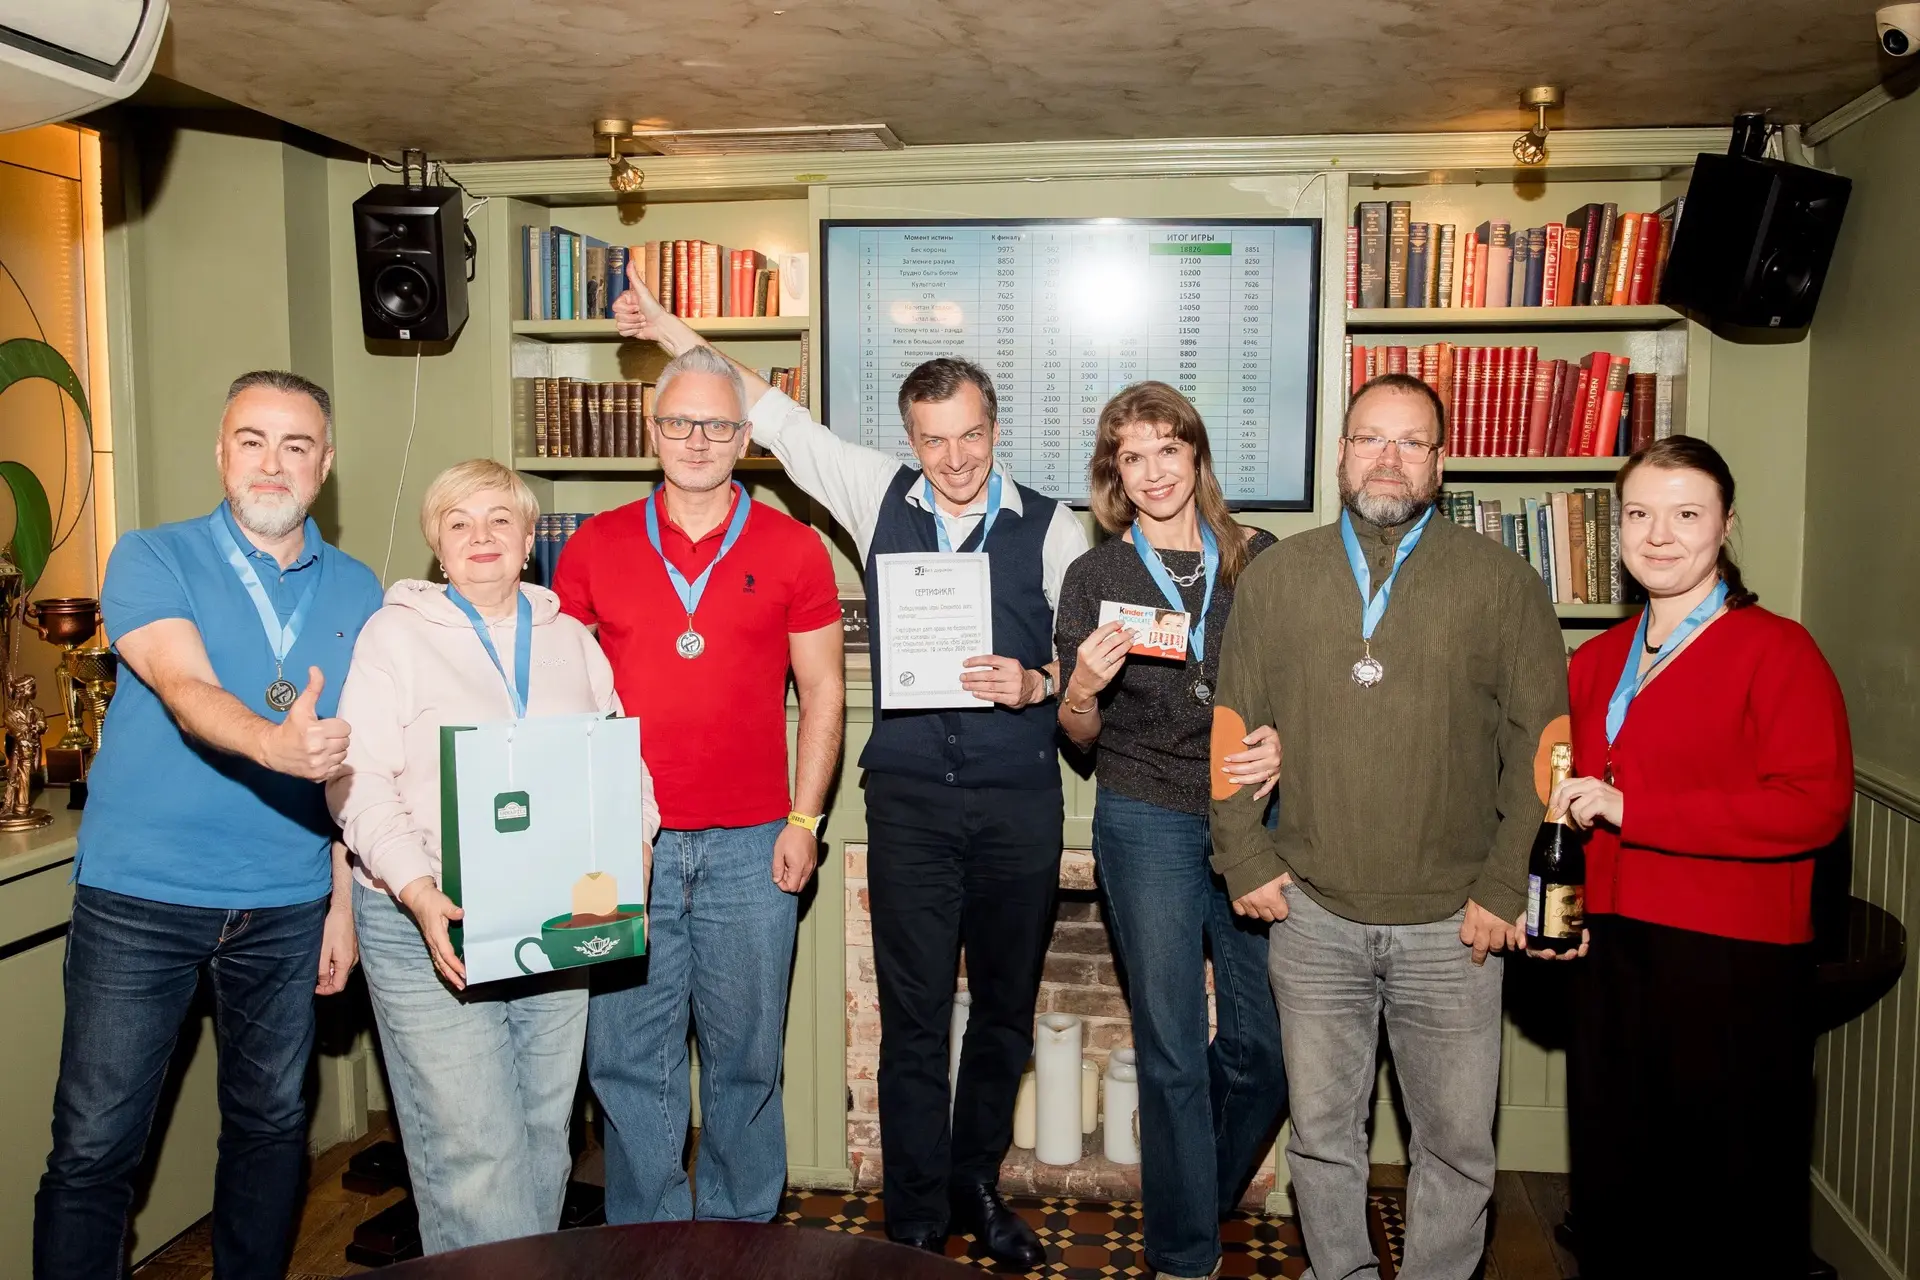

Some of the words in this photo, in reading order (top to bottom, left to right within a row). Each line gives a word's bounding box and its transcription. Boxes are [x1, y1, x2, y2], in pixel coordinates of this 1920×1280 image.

[996, 234, 1021, 242] финалу
[996, 257, 1015, 265] 8850
[1179, 257, 1202, 265] 17100
[899, 269, 921, 277] Трудно
[1178, 327, 1200, 335] 11500
[996, 349, 1015, 357] 4450
[1045, 349, 1057, 357] -50
[1179, 361, 1197, 369] 8200
[1046, 372, 1056, 380] 50
[1080, 372, 1098, 380] 3900
[997, 383, 1014, 391] 3050
[1587, 378, 1599, 408] SLADEN
[1042, 406, 1058, 414] -600
[1082, 406, 1096, 414] 600
[1040, 417, 1061, 425] -1500
[1082, 417, 1095, 425] 550
[1582, 409, 1594, 448] ELISABETH
[1040, 440, 1060, 448] -5000
[1040, 451, 1060, 459] -5750
[914, 587, 956, 596] СЕРТИФИКАТ
[1119, 606, 1144, 617] Kinder
